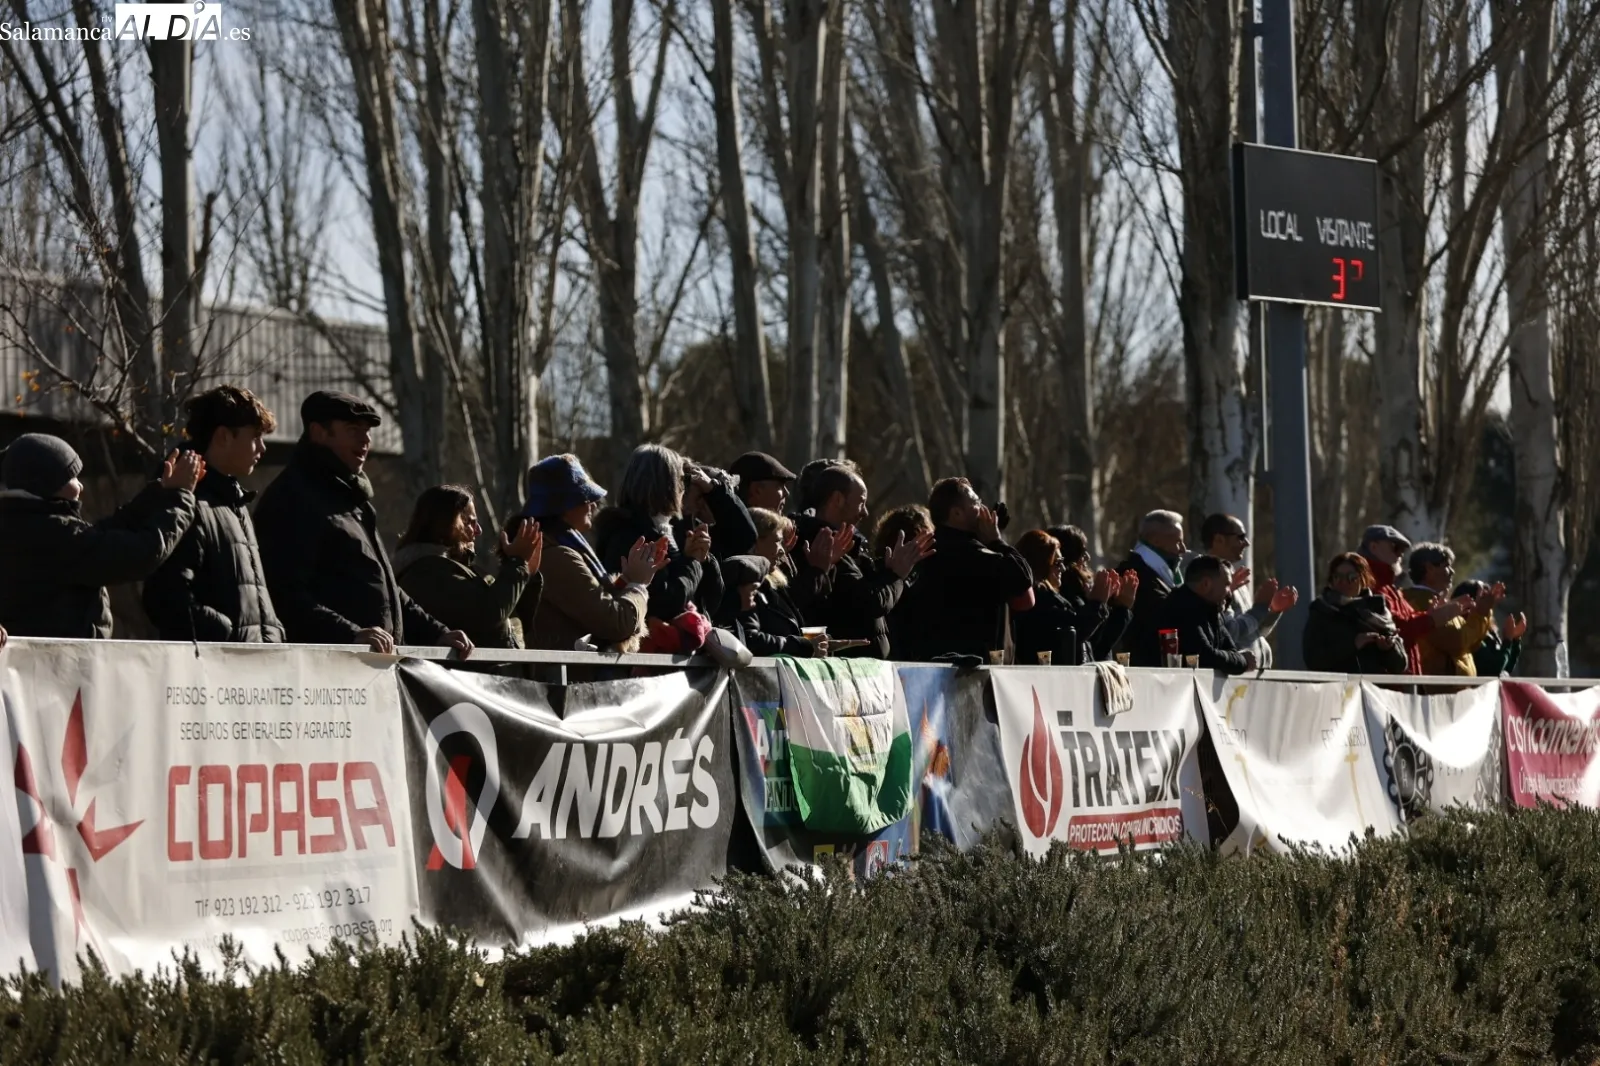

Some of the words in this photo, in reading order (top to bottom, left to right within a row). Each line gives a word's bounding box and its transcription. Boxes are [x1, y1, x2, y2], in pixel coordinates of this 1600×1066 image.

[1260, 209, 1303, 242] LOCAL
[166, 687, 207, 705] PIENSOS
[217, 687, 294, 705] CARBURANTES
[303, 688, 367, 705] SUMINISTROS
[180, 721, 229, 740] SEGUROS
[231, 721, 293, 740] GENERALES
[294, 721, 302, 739] Y
[302, 721, 352, 739] AGRARIOS
[511, 727, 720, 839] ANDRÉS
[168, 761, 396, 862] COPASA
[1070, 819, 1120, 842] PROTECCIÓN
[214, 898, 235, 917] 923
[239, 896, 259, 915] 192
[263, 894, 283, 914] 312
[293, 892, 315, 911] 923
[318, 889, 342, 909] 192
[346, 886, 370, 906] 317
